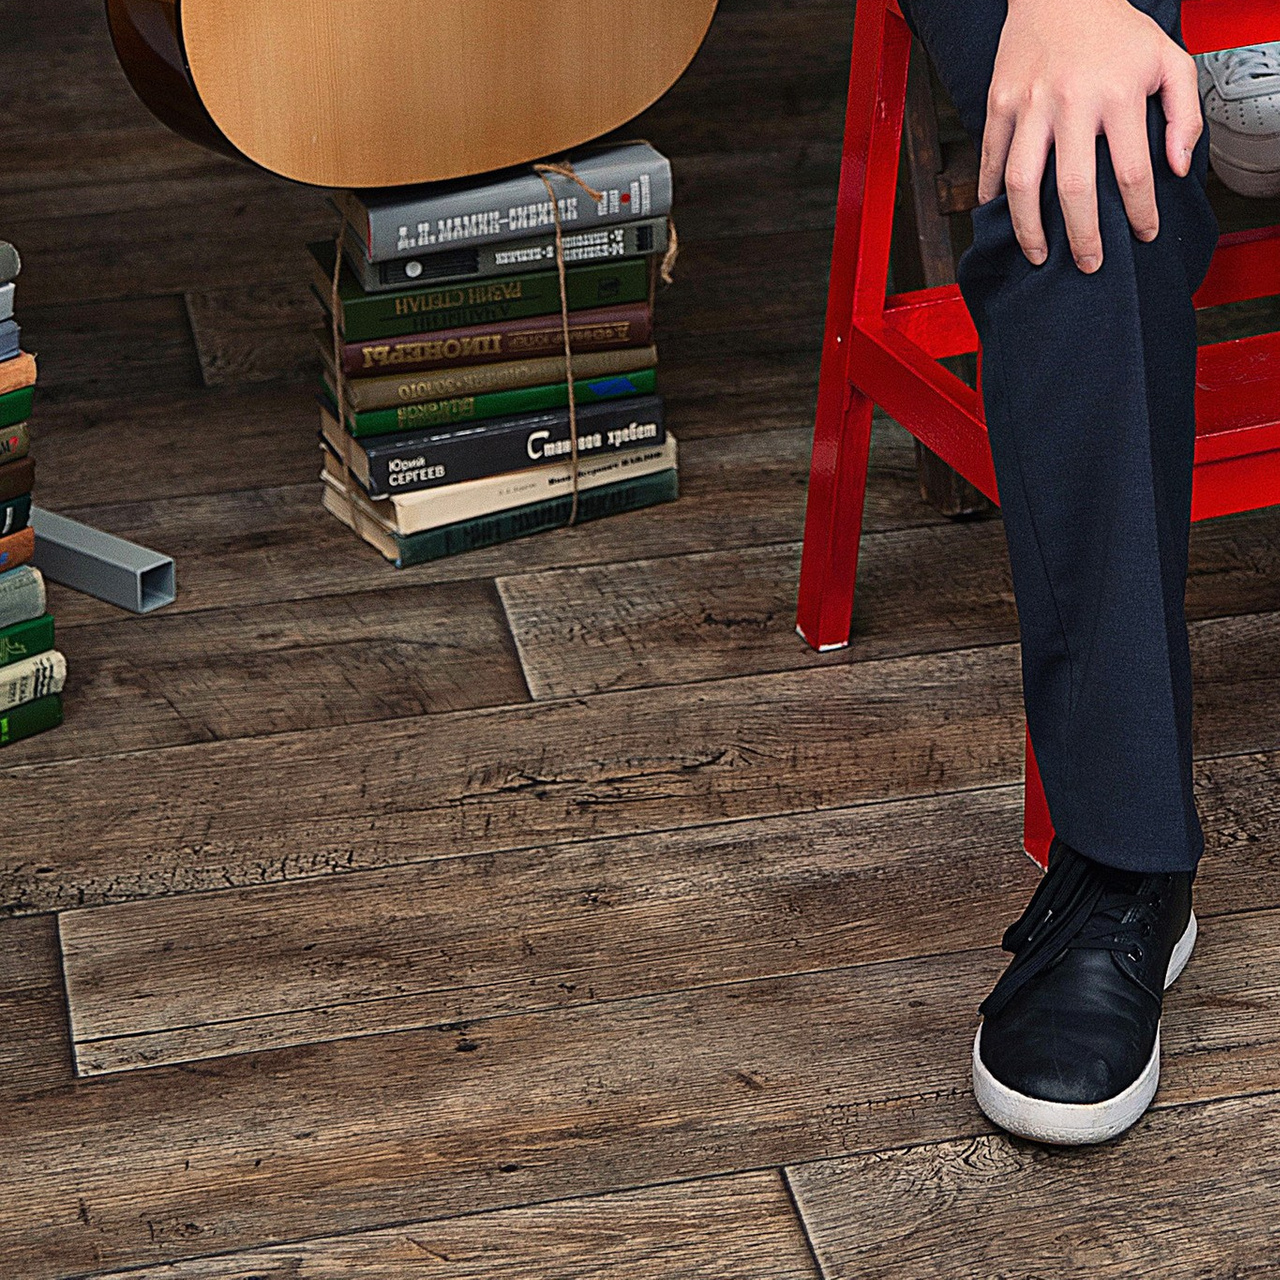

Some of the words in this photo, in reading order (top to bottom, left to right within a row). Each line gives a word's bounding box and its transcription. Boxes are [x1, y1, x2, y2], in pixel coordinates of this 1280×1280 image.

[395, 290, 465, 315] СТЕПАН
[468, 282, 522, 304] РАЗИН
[362, 335, 501, 369] ПИОНЕРЫ
[526, 430, 603, 460] Станвой
[607, 422, 658, 447] хребет
[388, 456, 426, 474] Юрий
[389, 464, 446, 487] СЕРГЕЕВ
